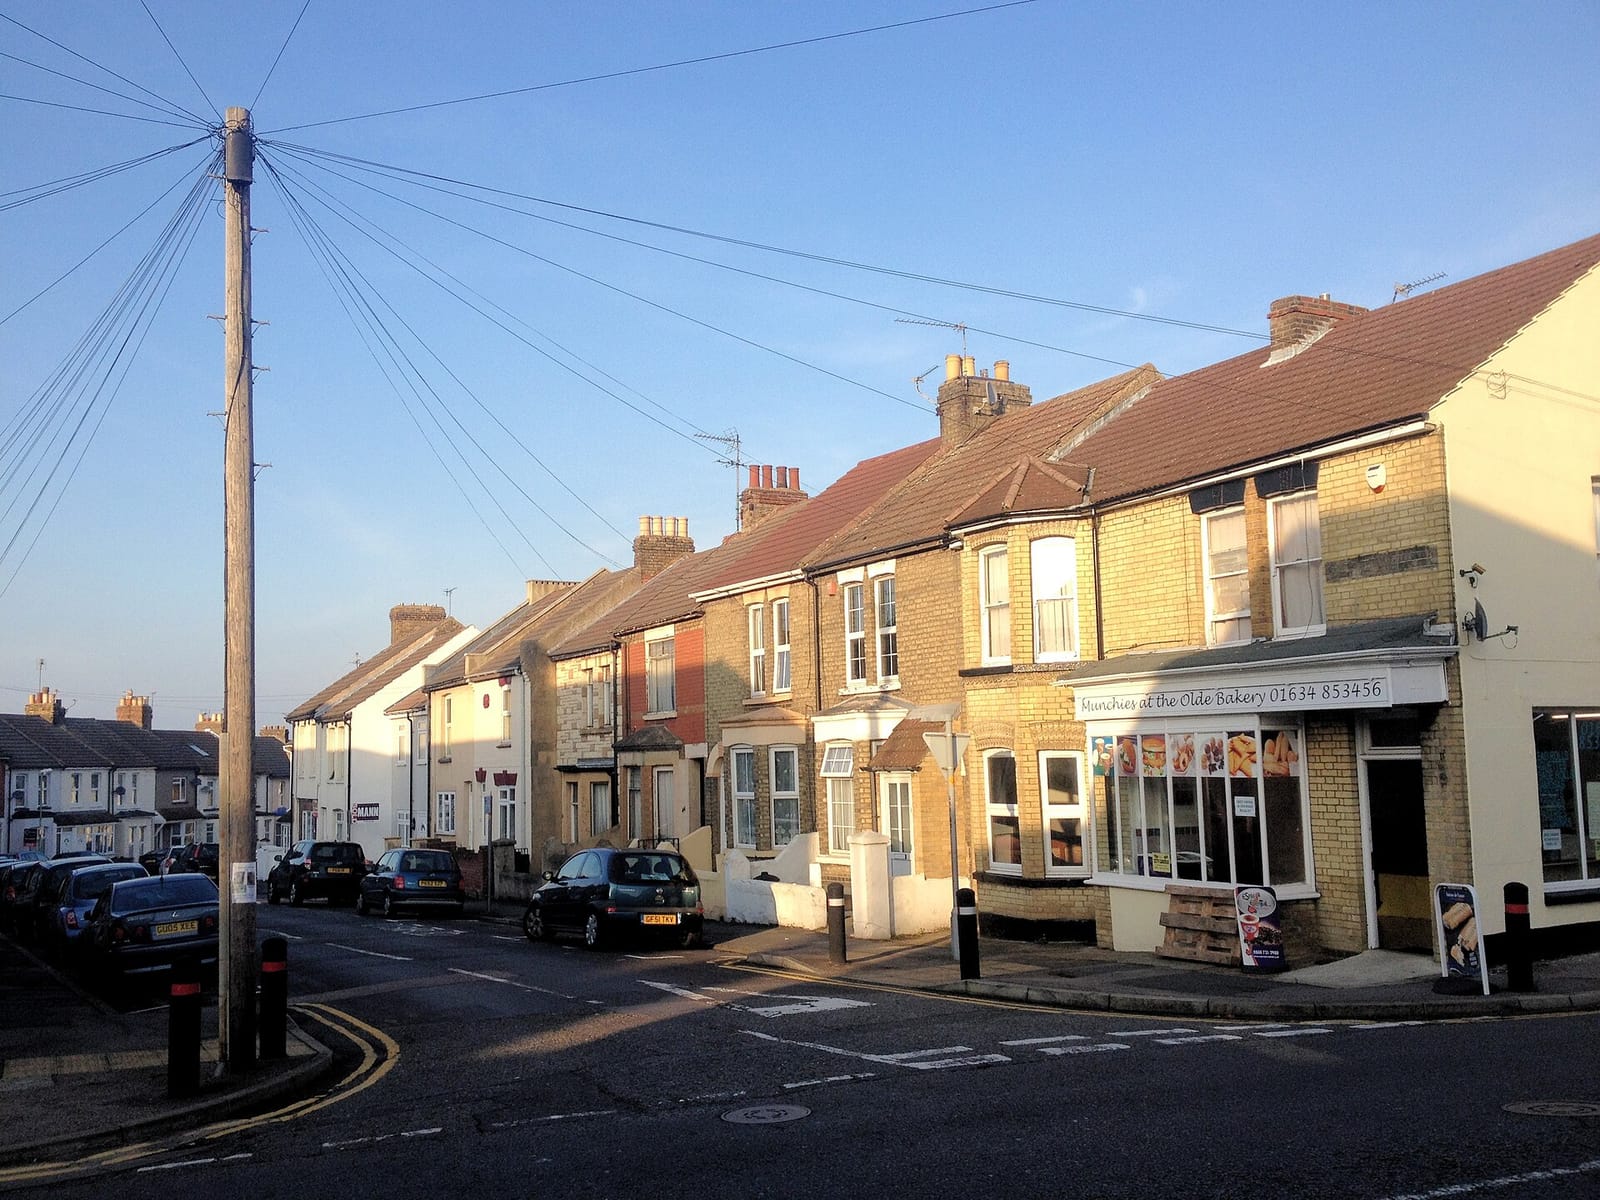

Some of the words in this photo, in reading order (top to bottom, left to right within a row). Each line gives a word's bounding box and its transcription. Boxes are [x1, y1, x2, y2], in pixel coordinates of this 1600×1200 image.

[1081, 696, 1137, 713] Munchies
[1139, 696, 1152, 709] at
[1156, 693, 1178, 708] the
[1180, 691, 1212, 706] Olde
[1214, 688, 1267, 707] Bakery
[1270, 685, 1316, 702] 01634
[1322, 681, 1382, 700] 853456
[357, 806, 379, 817] MANN
